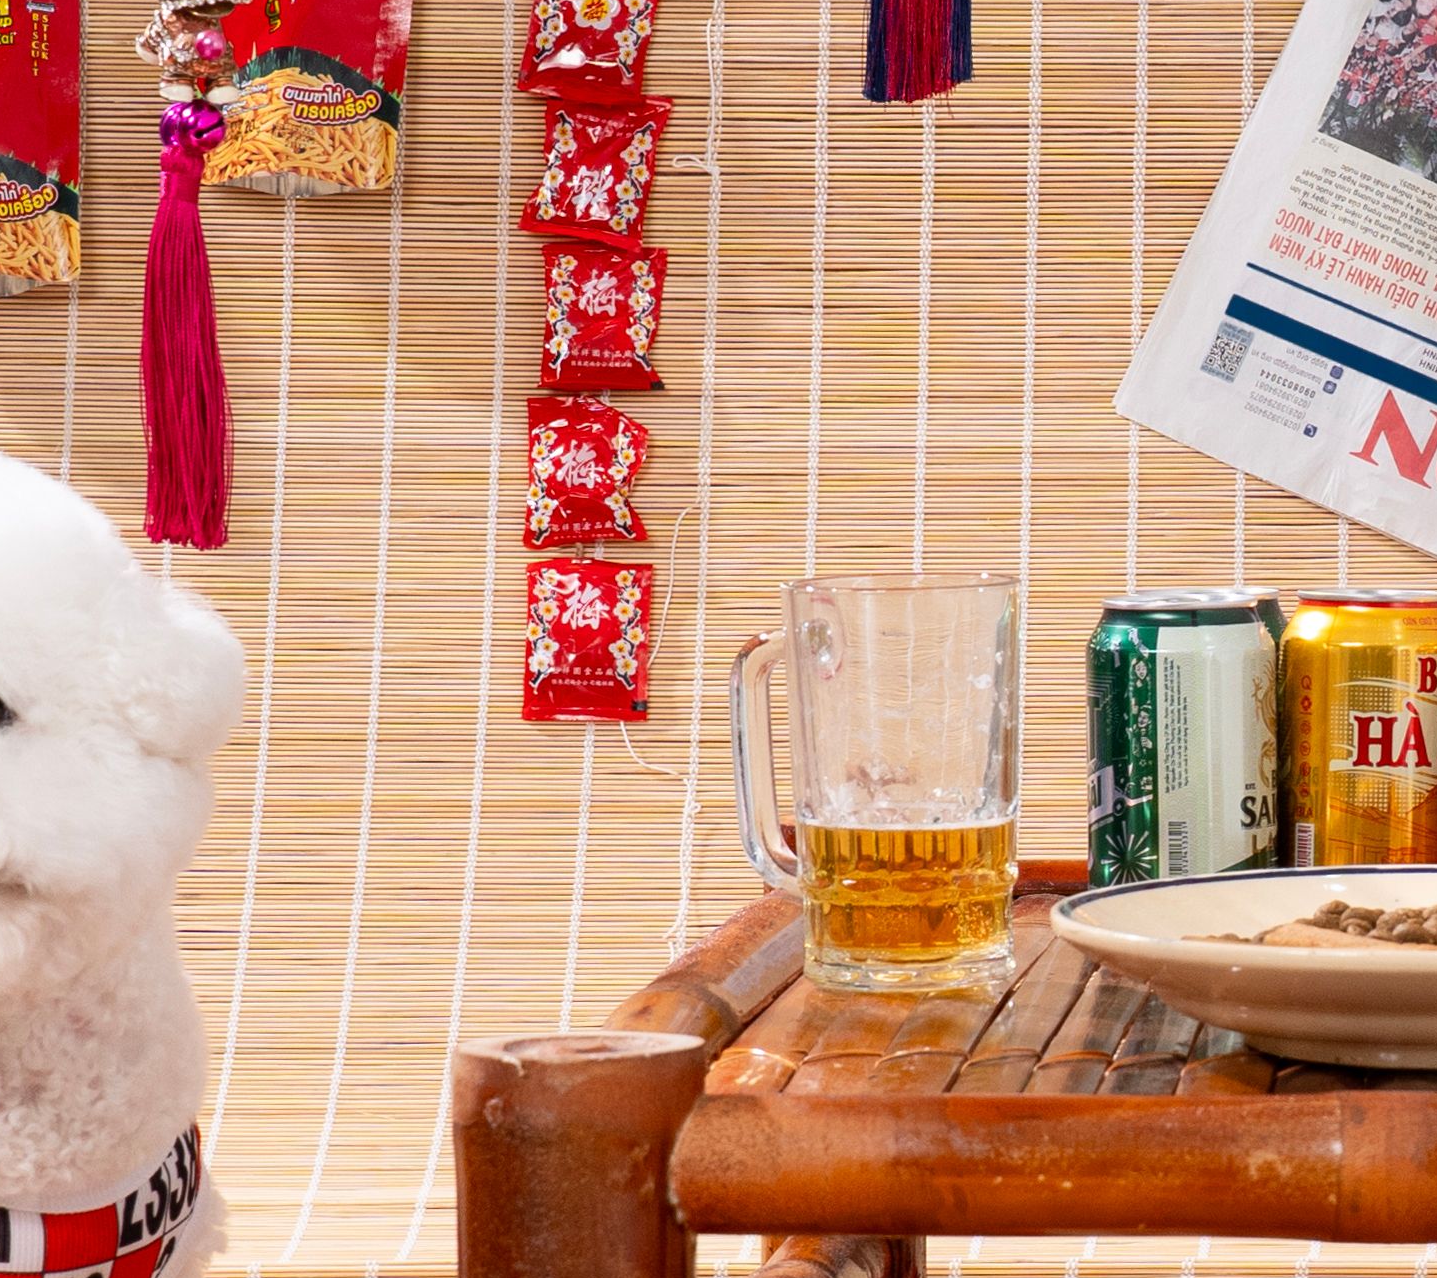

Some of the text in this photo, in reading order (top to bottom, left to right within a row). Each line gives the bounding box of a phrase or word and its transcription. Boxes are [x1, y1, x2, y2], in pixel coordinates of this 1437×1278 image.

[293, 92, 379, 121] ทรงเครื่อง
[562, 582, 611, 631] 梅
[1353, 702, 1433, 767] HÀ
